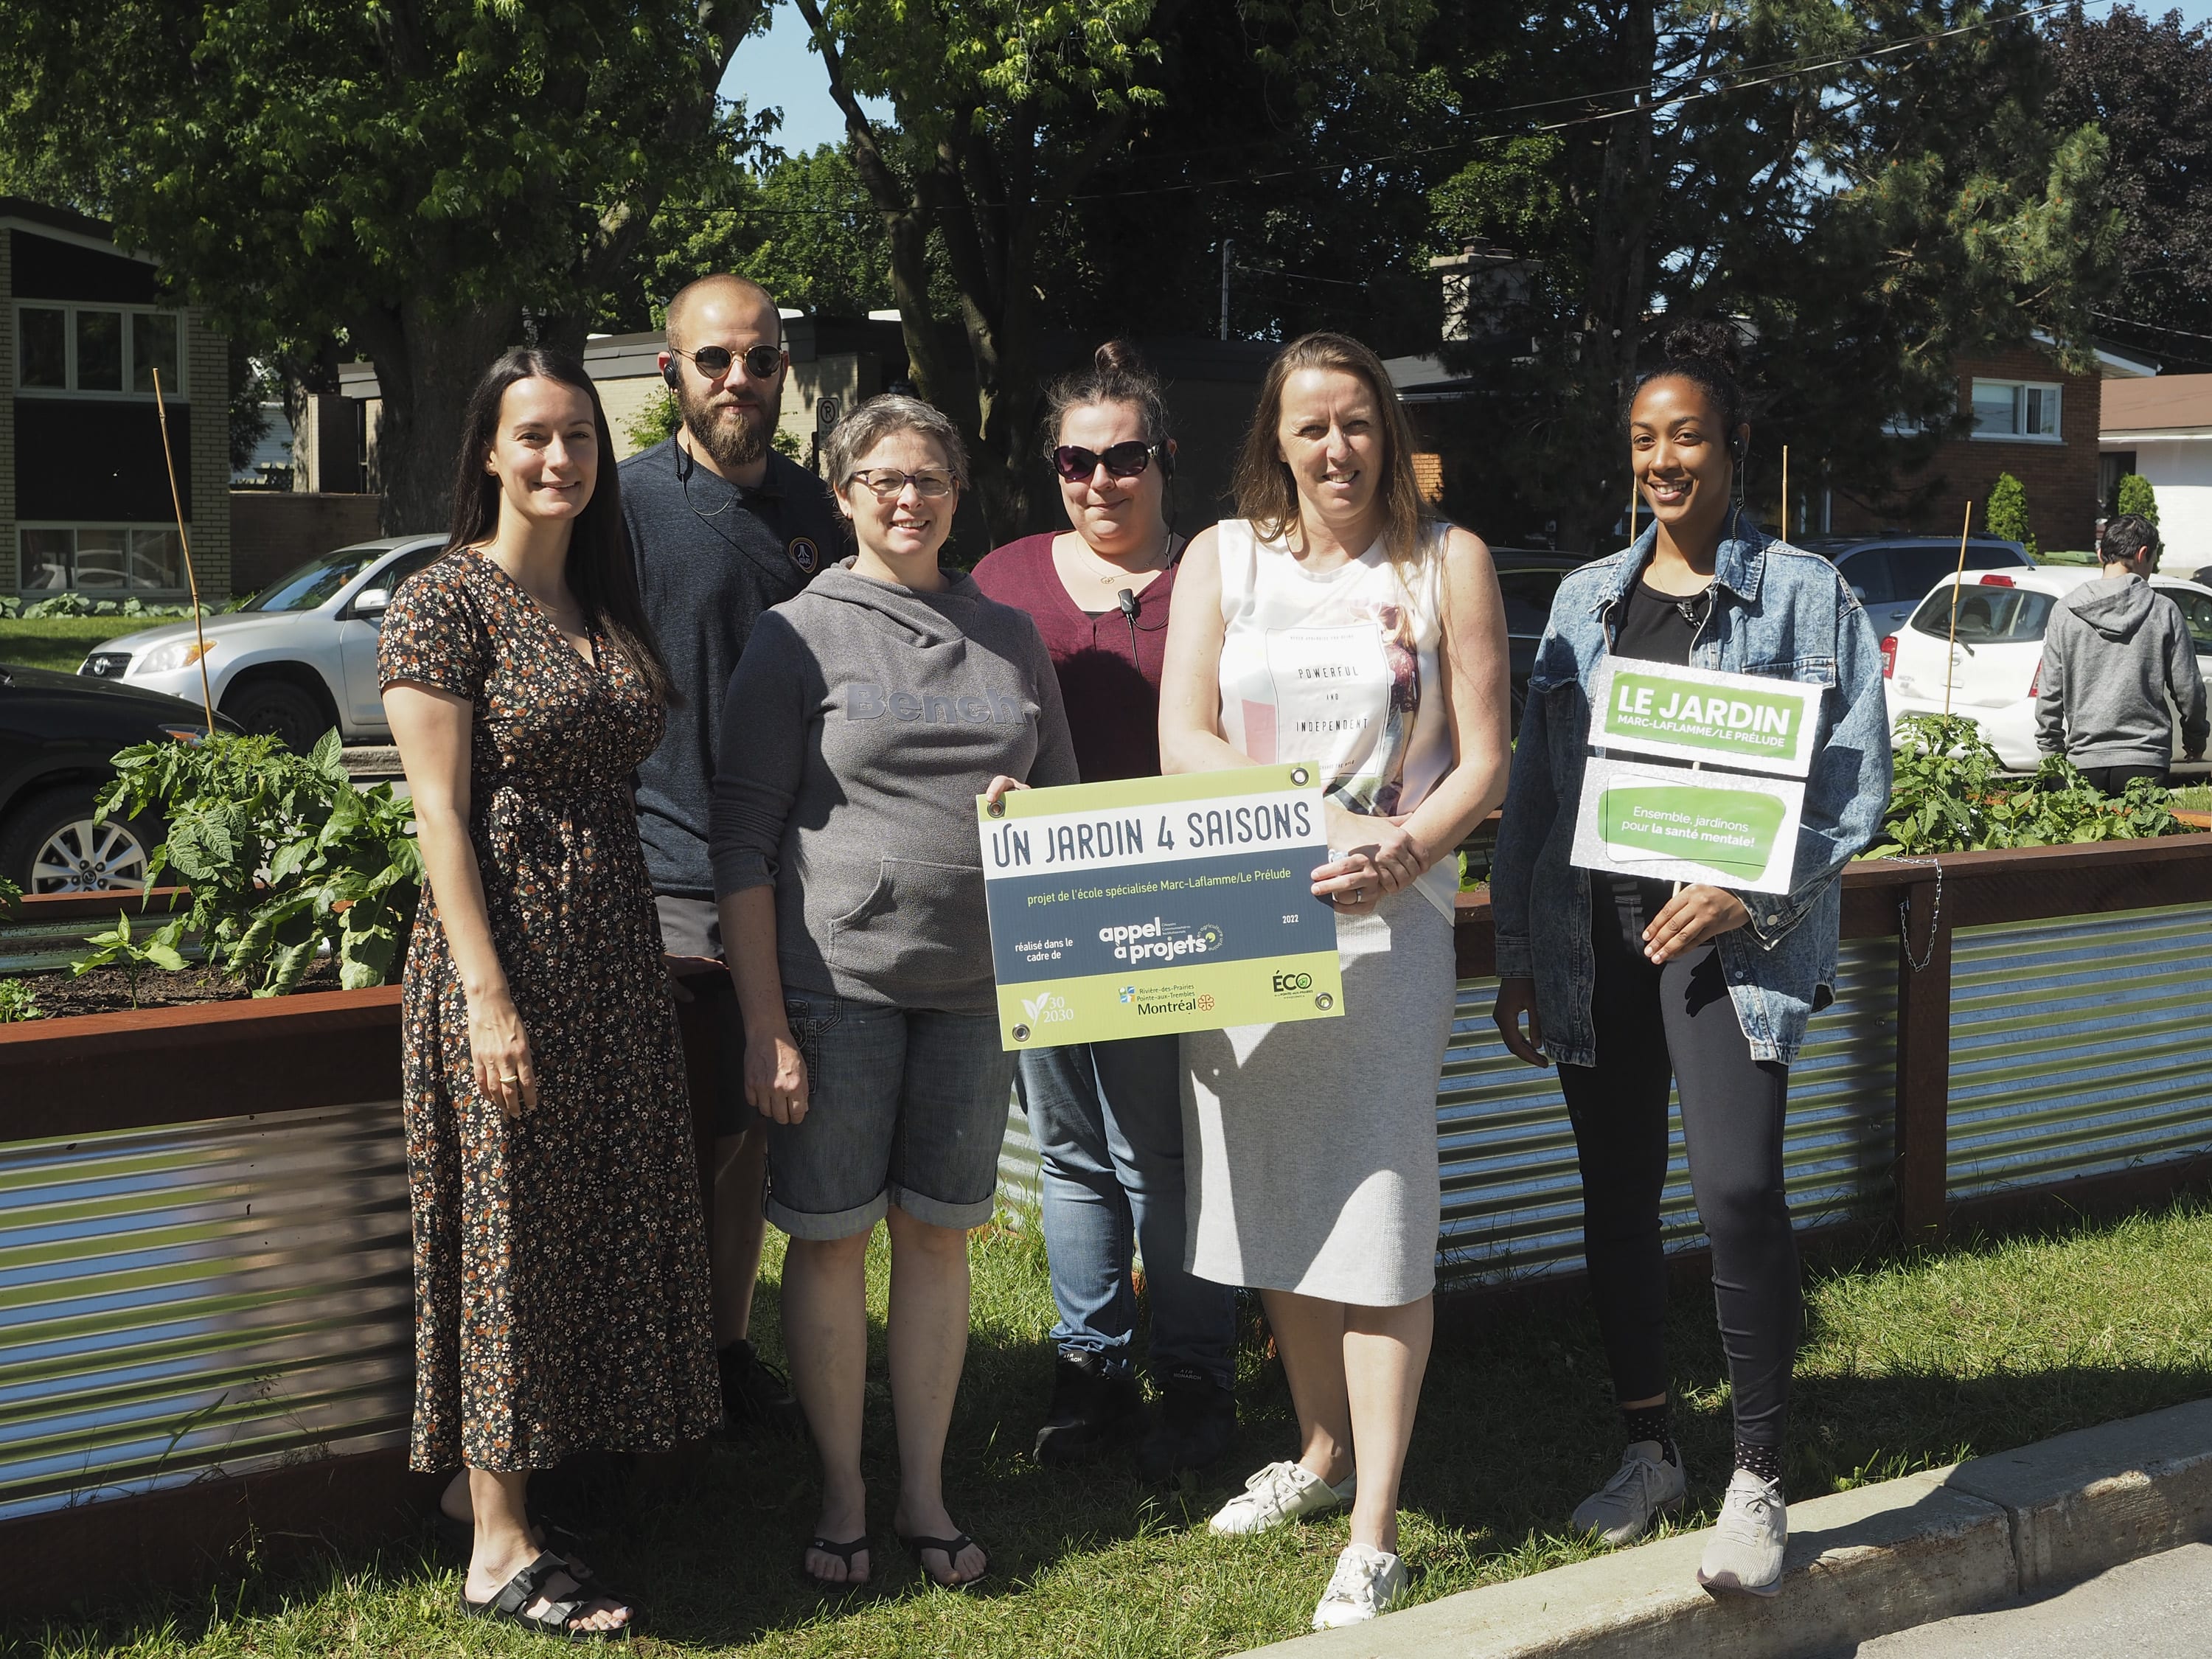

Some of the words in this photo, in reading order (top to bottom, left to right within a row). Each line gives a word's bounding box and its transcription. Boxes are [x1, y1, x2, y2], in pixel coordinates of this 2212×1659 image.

[1298, 666, 1359, 679] POWERFUL
[1326, 693, 1339, 701] AND
[1618, 685, 1655, 716] LE
[1659, 692, 1790, 735] JARDIN
[1296, 718, 1368, 732] INDEPENDENT
[1618, 714, 1732, 740] MARC-LAFLAMME/LE
[1734, 729, 1786, 748] PRÉLUDE
[1695, 815, 1749, 832] jardinons
[992, 823, 1032, 868] UN
[1046, 815, 1144, 863] JARDIN
[1157, 815, 1175, 851] 4
[1188, 801, 1311, 848] SAISONS
[1621, 819, 1650, 833] pour
[1652, 822, 1663, 835] la
[1664, 825, 1698, 840] santé
[1700, 832, 1756, 848] mentale!
[1027, 892, 1055, 907] projet
[1057, 890, 1069, 902] de
[1071, 887, 1103, 900] l'école
[1105, 881, 1158, 898] spécialisée
[1160, 872, 1252, 891] Marc-Laflamme/Le
[1254, 867, 1291, 882] Prélude
[1281, 914, 1299, 924] 2022
[1099, 917, 1162, 945] appel
[1015, 940, 1043, 952] réalisé
[1044, 939, 1064, 949] dans
[1065, 937, 1074, 947] le
[1114, 941, 1127, 959] à
[1130, 934, 1207, 964] projets
[1026, 951, 1049, 962] cadre
[1051, 950, 1062, 959] de
[1139, 984, 1195, 994] Rivière-des-Prairies
[1273, 970, 1312, 992] ÉCO
[1049, 996, 1065, 1009] 30
[1137, 991, 1195, 1002] Pointe-aux-Trembles
[1138, 998, 1197, 1015] Montréal
[1043, 1008, 1074, 1023] 2030
